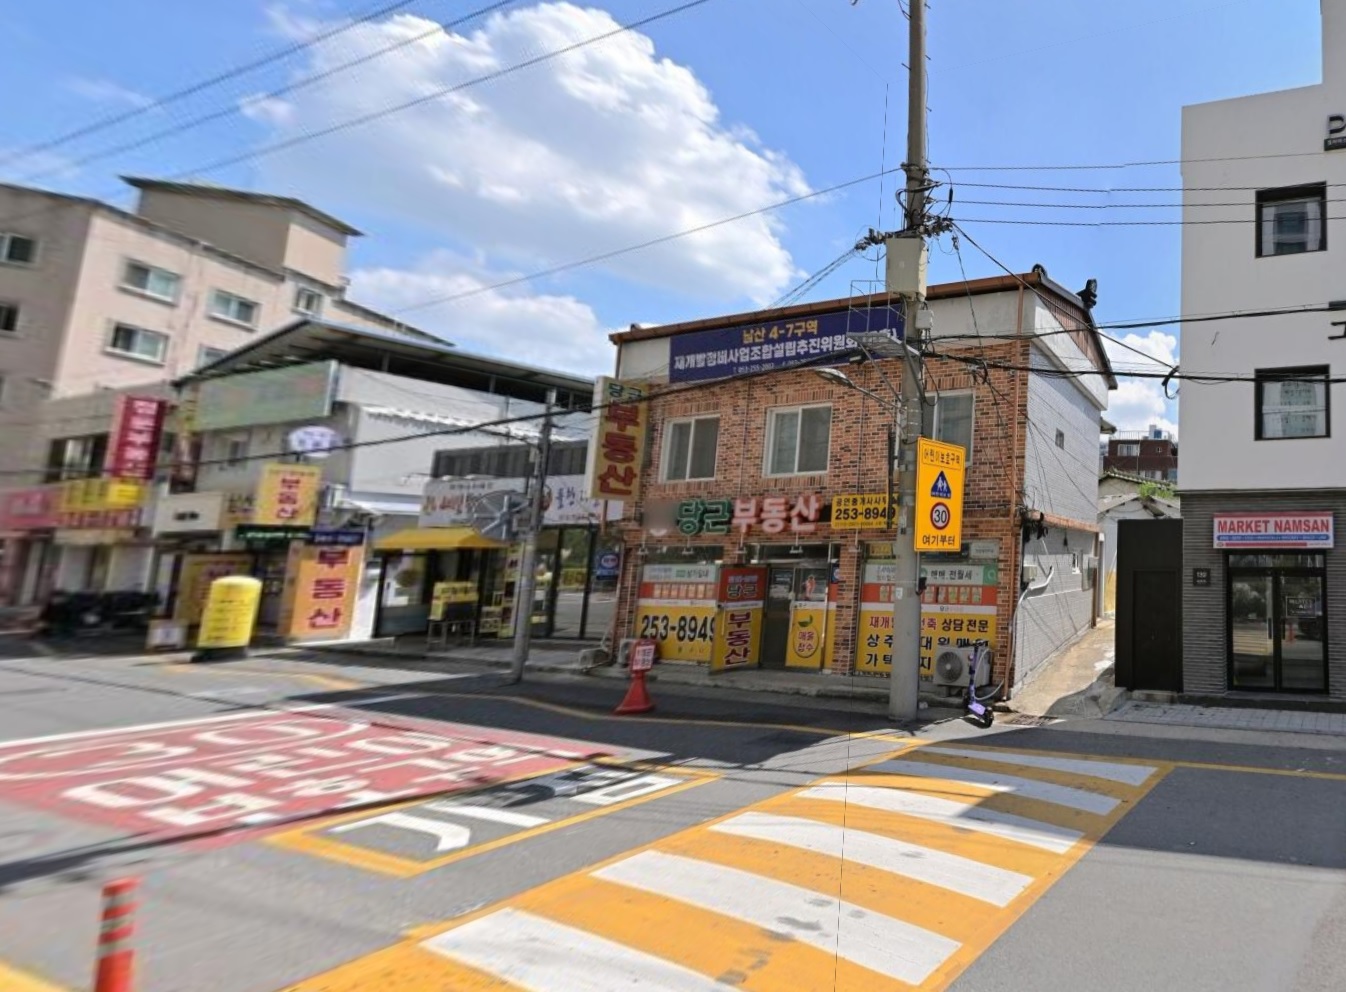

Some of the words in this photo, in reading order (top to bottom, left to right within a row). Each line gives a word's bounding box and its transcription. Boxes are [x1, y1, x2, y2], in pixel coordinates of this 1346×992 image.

[742, 328, 766, 345] 남산
[769, 319, 818, 341] 4-7구역
[598, 400, 640, 495] 부동산
[923, 447, 961, 465] 어린이보호구역
[276, 477, 301, 518] 부동산
[835, 507, 896, 521] 253-8949
[933, 509, 948, 524] 30
[1217, 520, 1270, 533] MARKET
[1274, 519, 1330, 533] NAMSAN
[922, 534, 956, 547] 여기부터
[309, 549, 349, 629] 부동산
[640, 614, 716, 642] 253-8949
[724, 611, 753, 665] 부동산
[941, 618, 964, 633] 상담
[966, 619, 989, 633] 전문
[62, 733, 452, 808] 어린이
